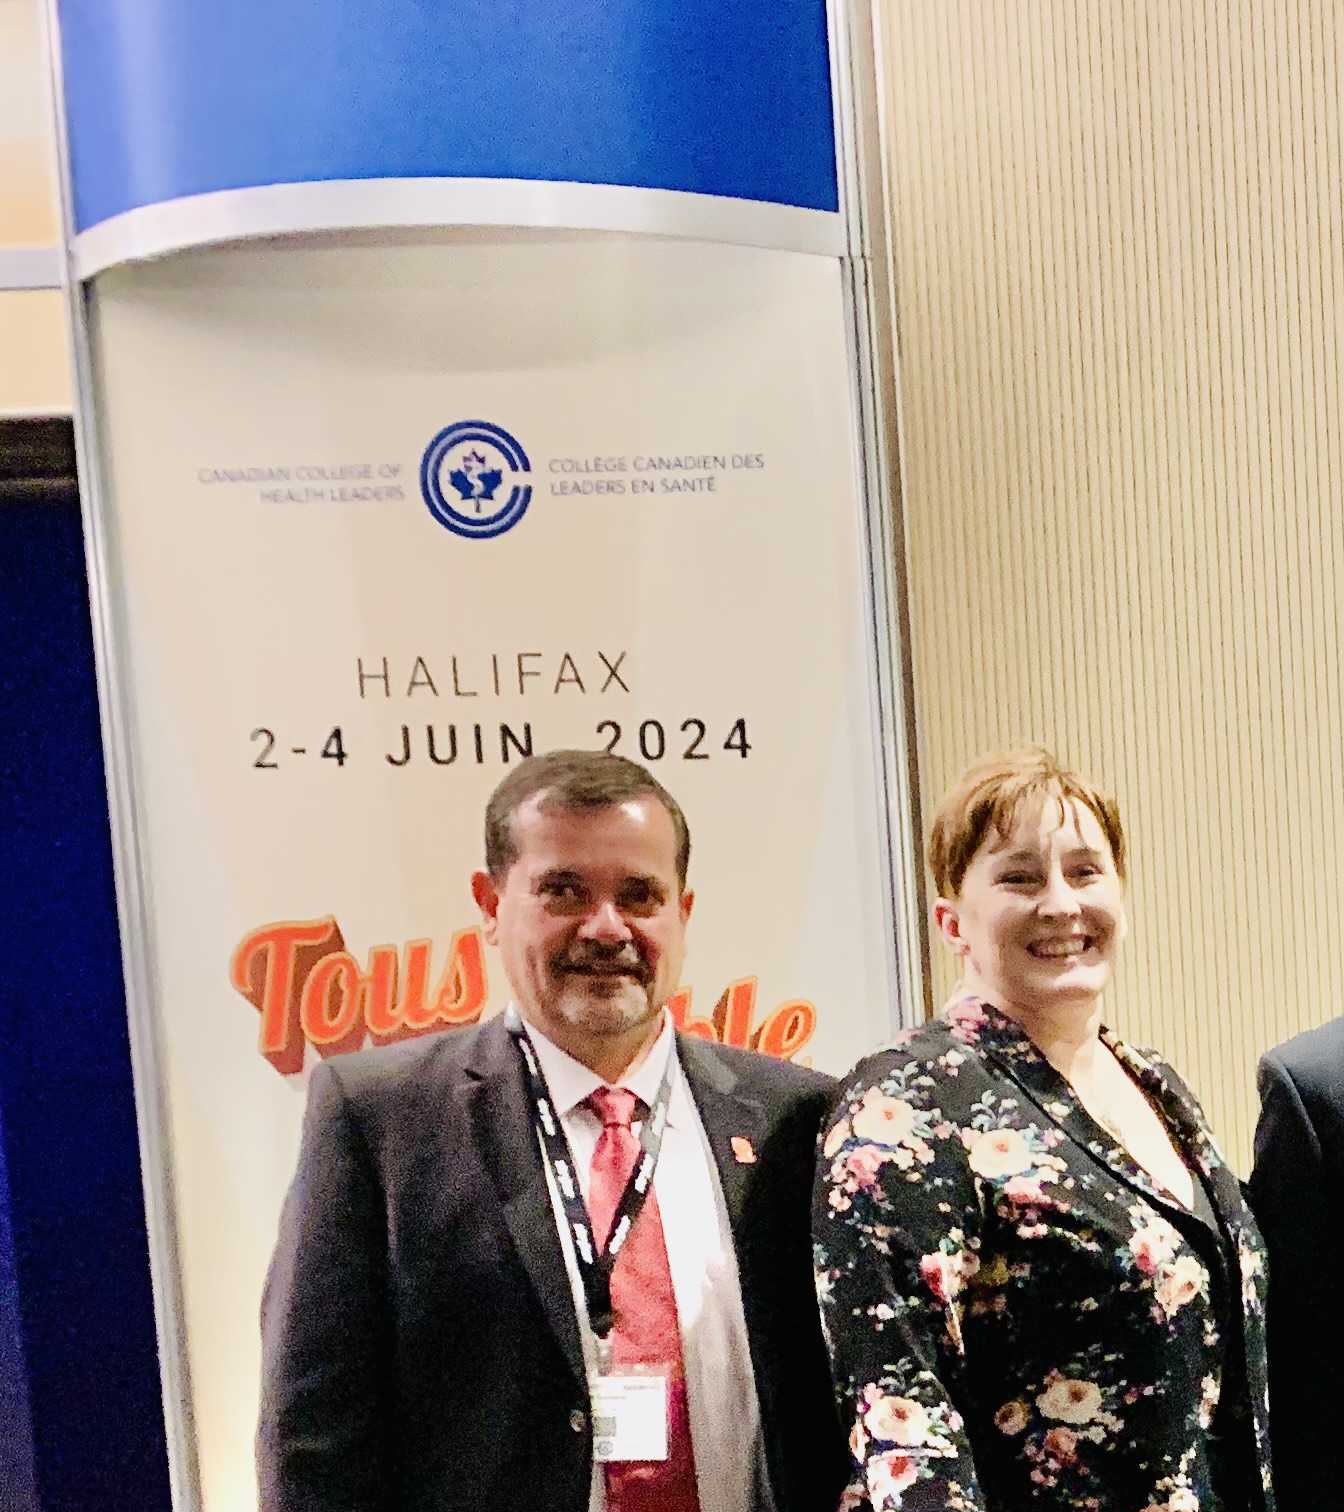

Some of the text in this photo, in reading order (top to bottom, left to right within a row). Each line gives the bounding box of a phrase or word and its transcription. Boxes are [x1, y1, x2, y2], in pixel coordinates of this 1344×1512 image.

[296, 464, 371, 481] COLLEGE
[632, 455, 726, 472] CANADIEN
[731, 453, 765, 469] DES
[331, 484, 405, 502] LEADERS
[550, 476, 716, 496] LEADERS EN SANTÉ
[357, 650, 631, 698] HALIFAX
[250, 718, 752, 769] 2-4 JUIN 2024
[230, 914, 489, 1075] Tous
